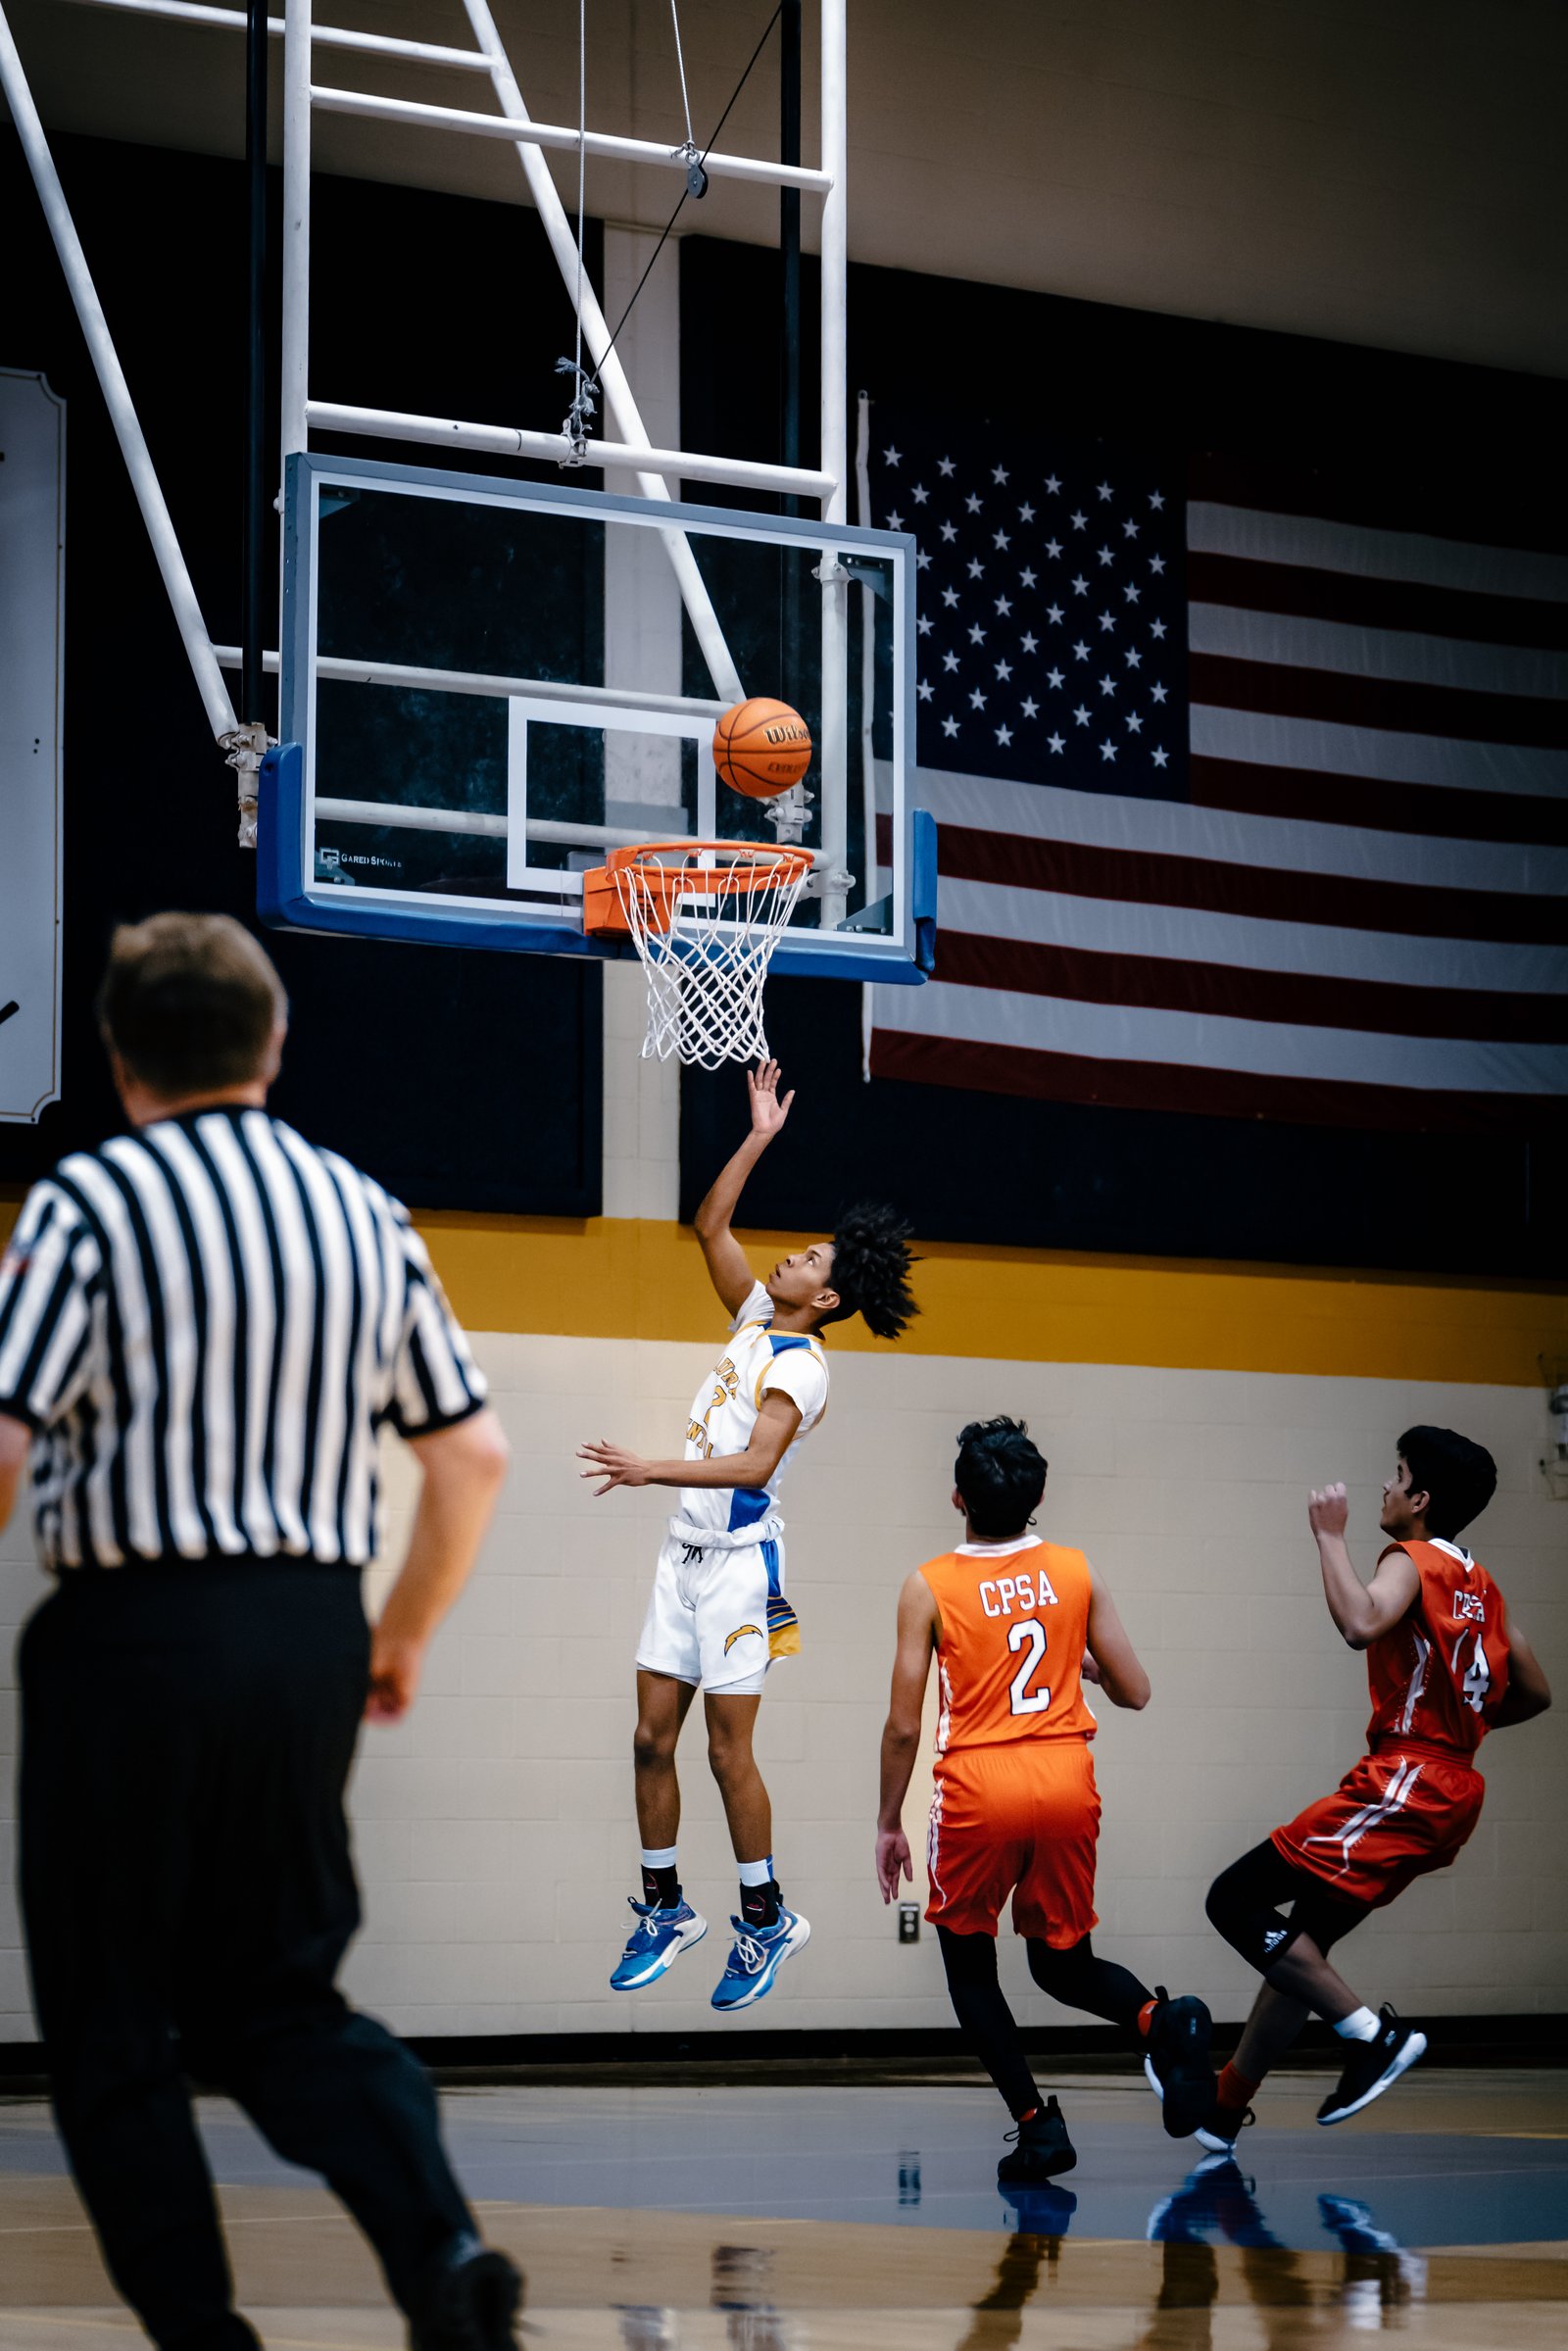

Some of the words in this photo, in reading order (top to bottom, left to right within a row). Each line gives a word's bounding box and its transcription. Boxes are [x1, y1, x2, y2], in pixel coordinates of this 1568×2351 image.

[763, 724, 810, 745] Wilso
[979, 1569, 1058, 1617] CPSA
[1007, 1617, 1052, 1716] 2
